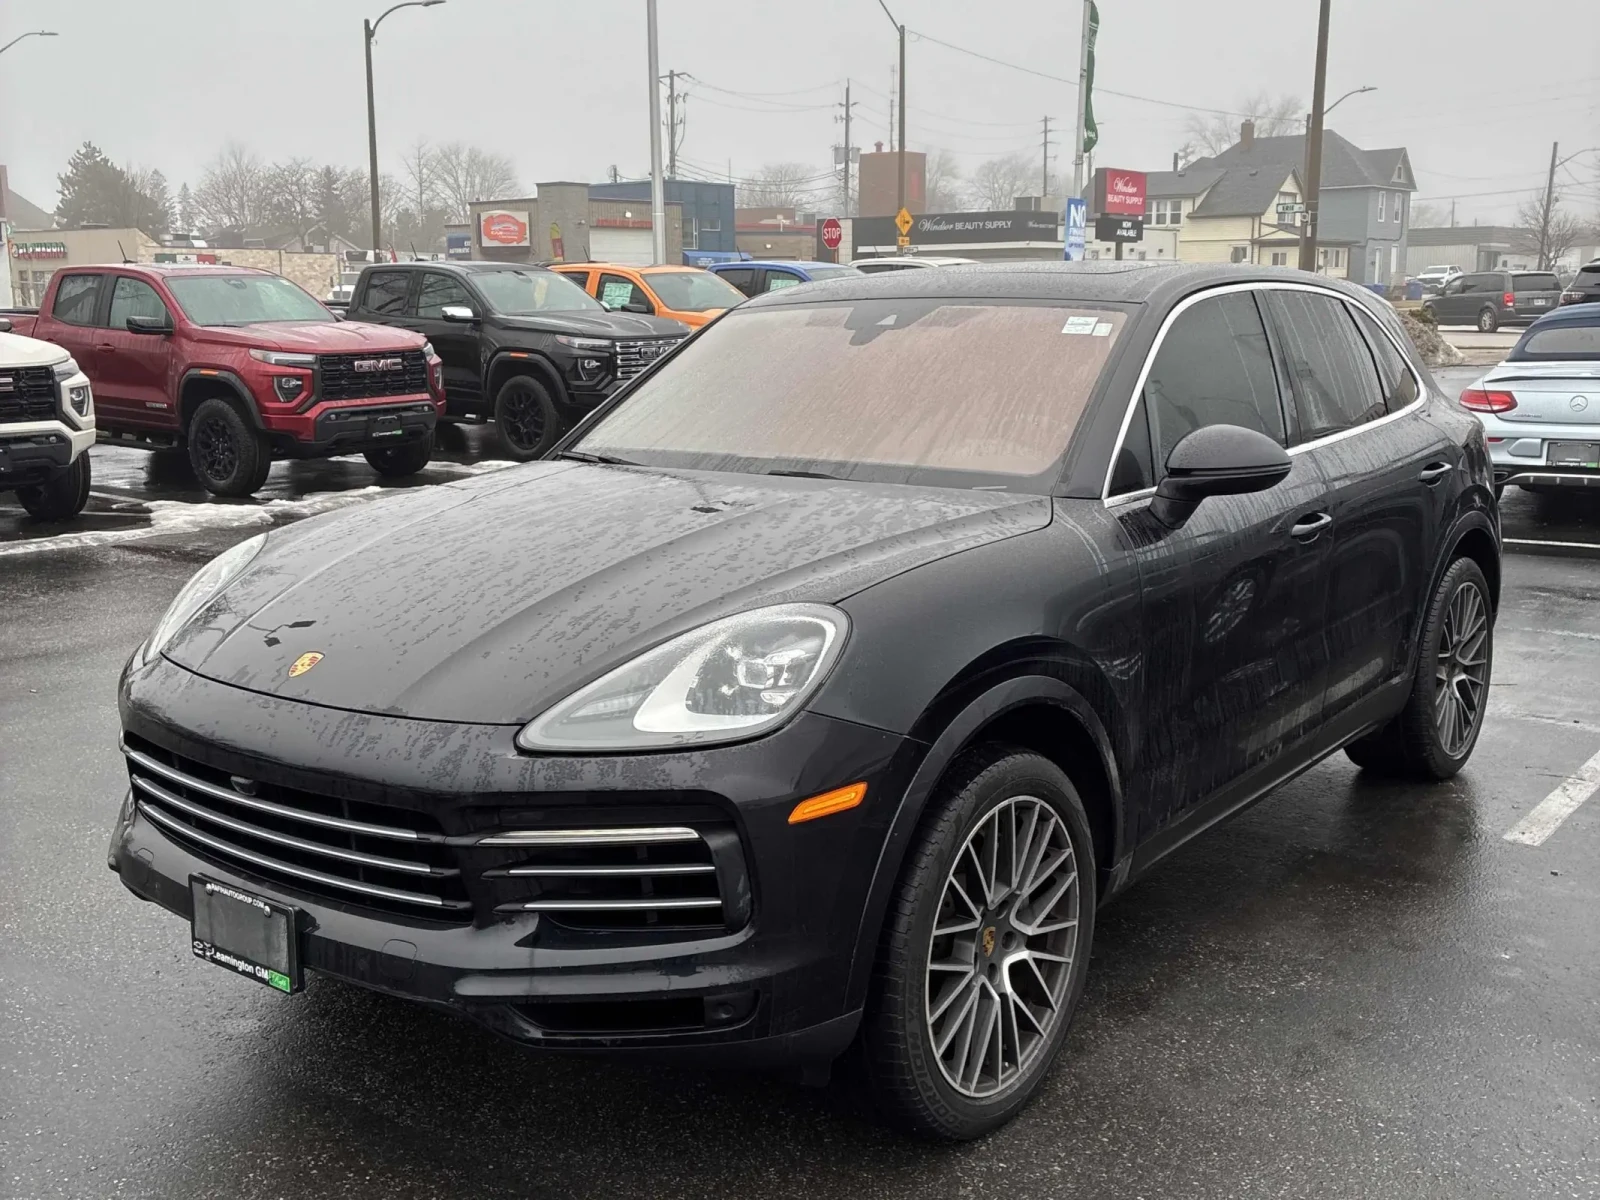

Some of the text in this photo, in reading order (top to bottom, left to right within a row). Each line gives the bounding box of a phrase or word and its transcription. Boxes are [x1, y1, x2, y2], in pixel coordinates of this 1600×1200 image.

[1107, 194, 1143, 205] BEAUTY SUPPLY
[918, 216, 1012, 231] Windsor BEAUTY SUPPLY
[823, 227, 841, 240] STOP
[354, 358, 402, 372] GMC
[212, 947, 269, 980] Leamington GM
